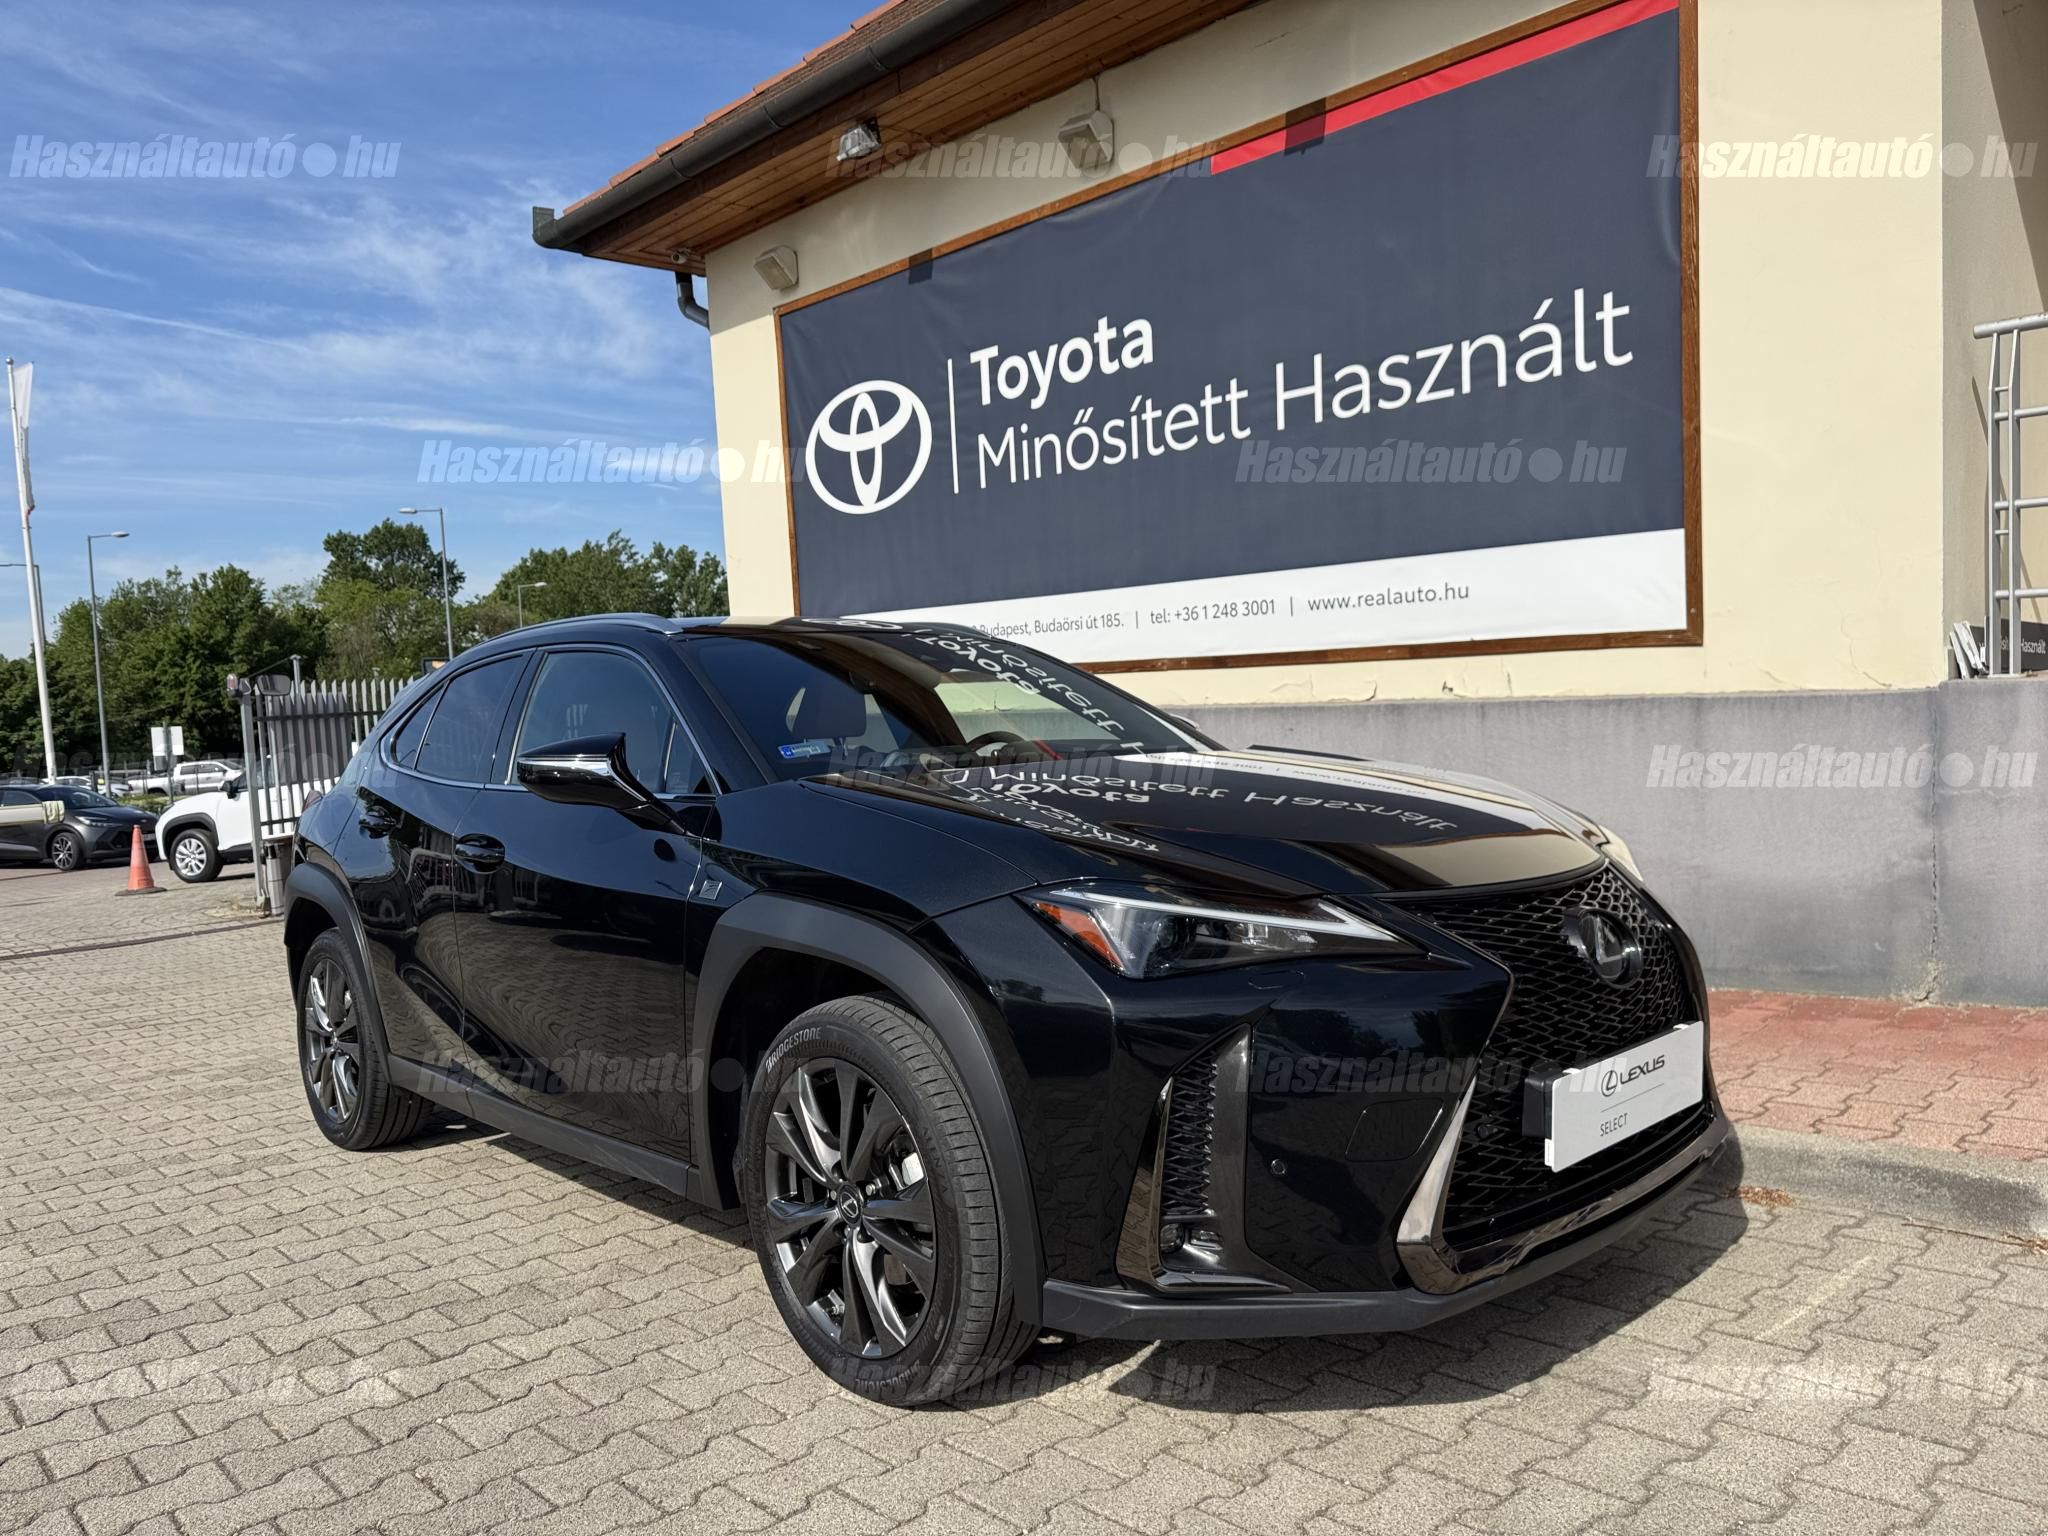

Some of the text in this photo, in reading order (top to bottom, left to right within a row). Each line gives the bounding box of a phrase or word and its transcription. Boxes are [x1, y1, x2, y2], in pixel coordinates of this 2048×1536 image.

[970, 316, 1154, 409] Toyota
[977, 288, 1633, 489] Minősített Használt
[1034, 617, 1083, 634] Budaörsi
[1086, 616, 1098, 630] út
[1101, 613, 1125, 629] 185.
[1150, 609, 1171, 625] tel:
[1174, 606, 1199, 622] +36
[1212, 602, 1239, 618] 248
[1242, 599, 1276, 617] 3001
[1307, 582, 1470, 612] www.realauto.hu
[766, 1026, 822, 1074] BRIDGESTONE
[1620, 1054, 1666, 1085] LEXUS
[1600, 1112, 1628, 1137] SELECT
